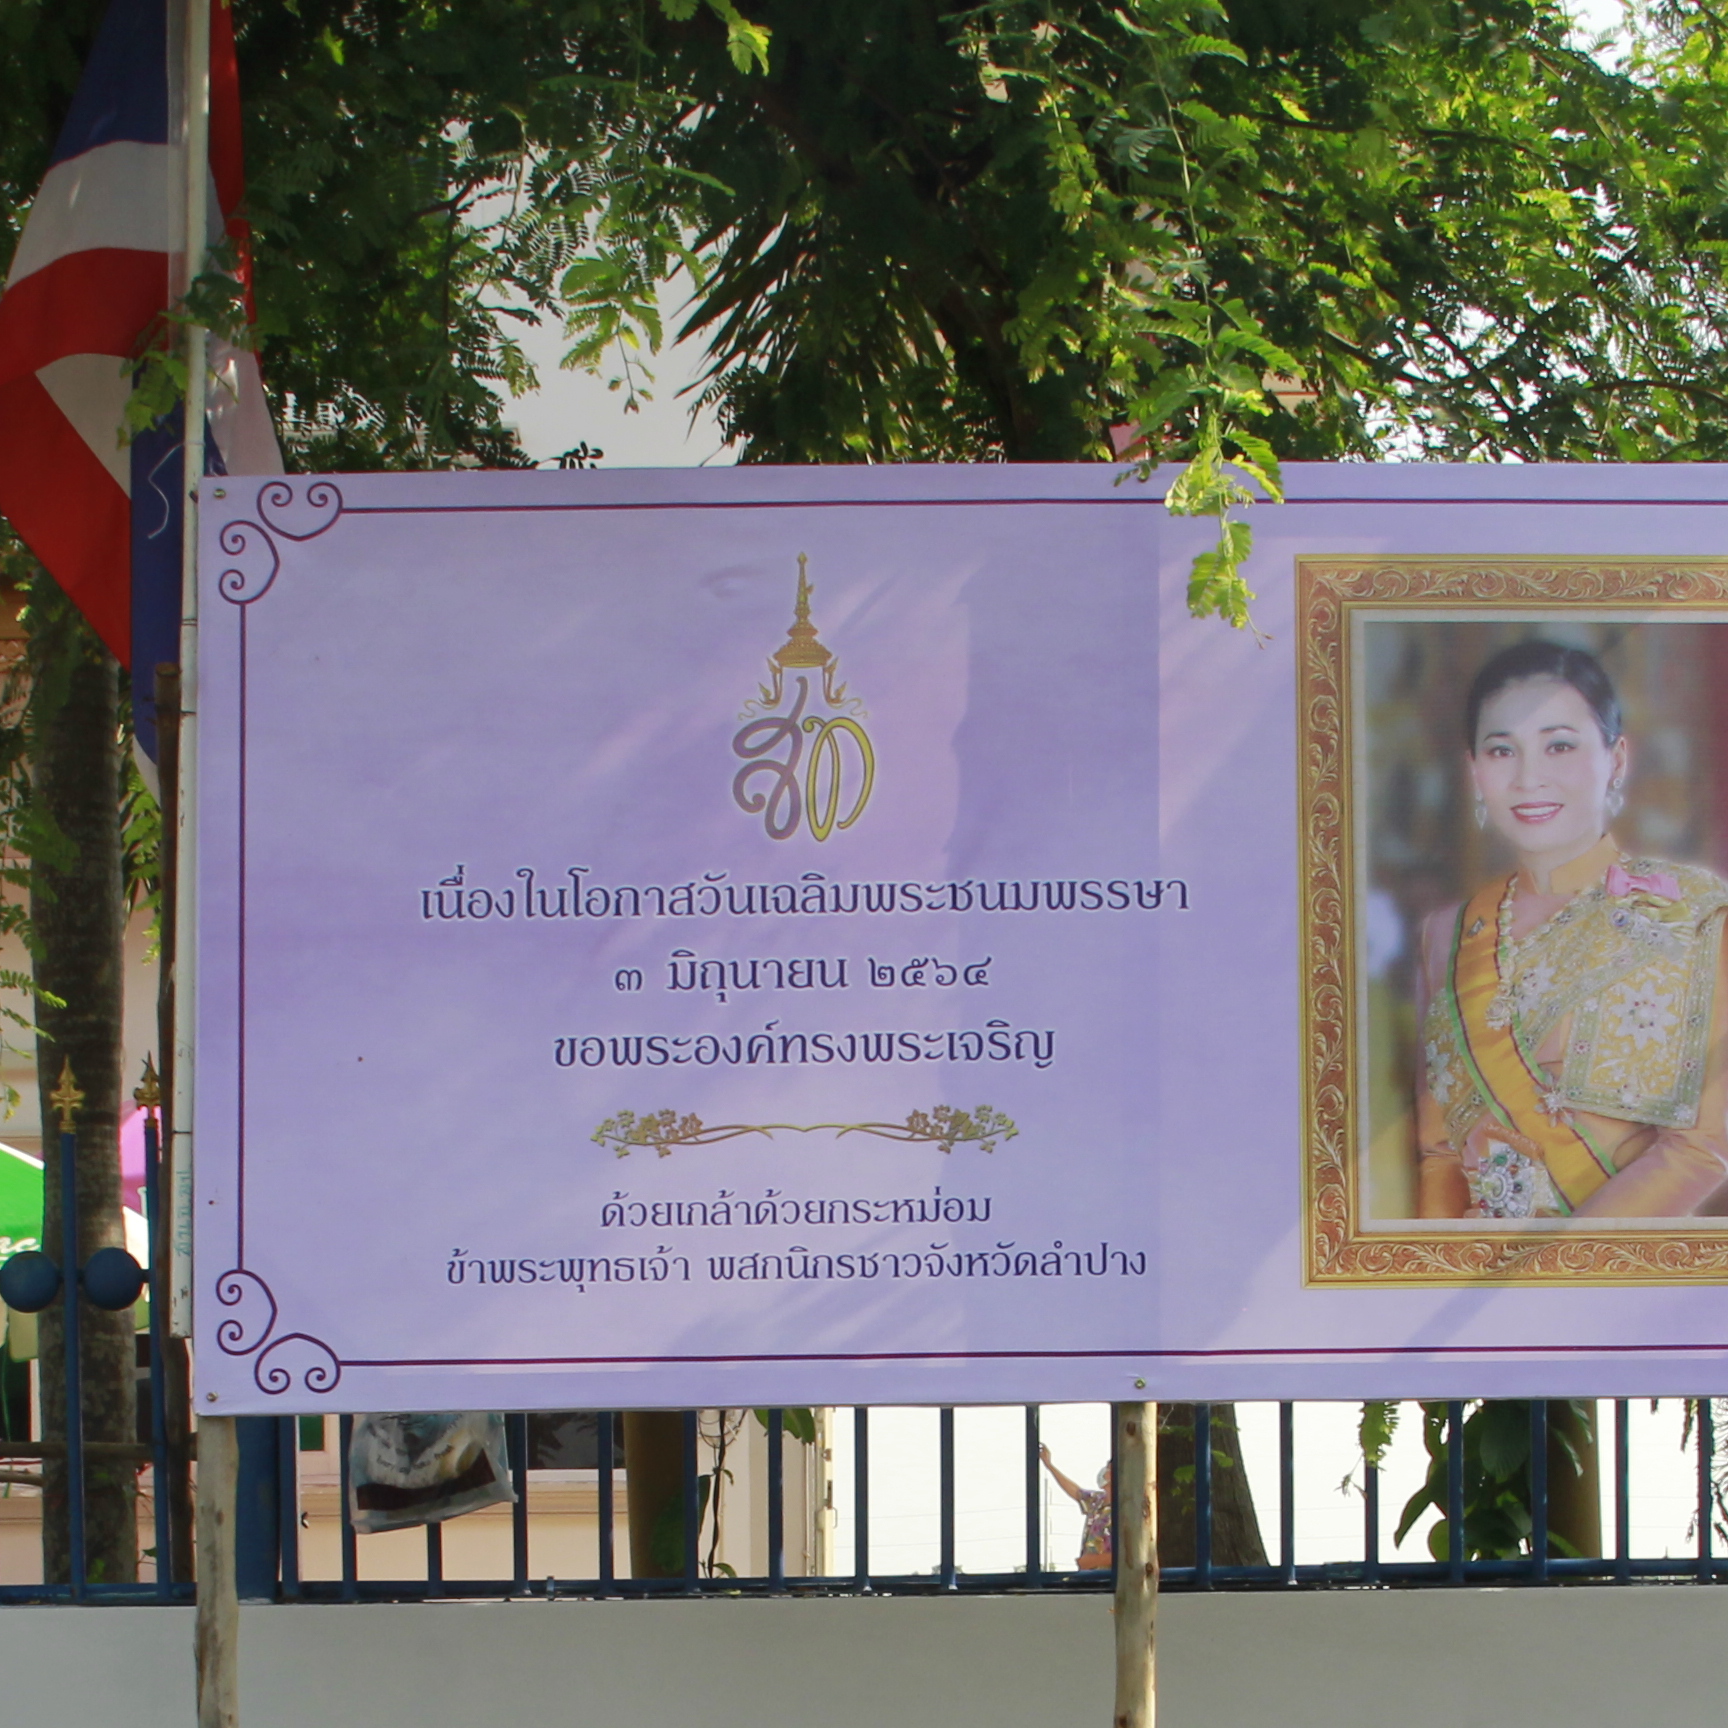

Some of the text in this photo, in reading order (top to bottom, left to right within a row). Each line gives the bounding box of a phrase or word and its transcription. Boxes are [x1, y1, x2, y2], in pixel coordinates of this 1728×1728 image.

[420, 865, 1190, 918] เนื่องในโอกาสวันเฉลิมพระชนมพรรษา
[614, 948, 993, 1002] ๓ มิถุนายน ๒๕๖๔
[553, 1019, 1056, 1070] ขอพระองค์ทรงพระเจริญ
[599, 1185, 992, 1229] ด้วยเกล้าด้วยกระหม่อม
[446, 1241, 1147, 1293] ข้าพระพุทธเจ้า พสกนิกรชาวจังหวัดลำปาง
